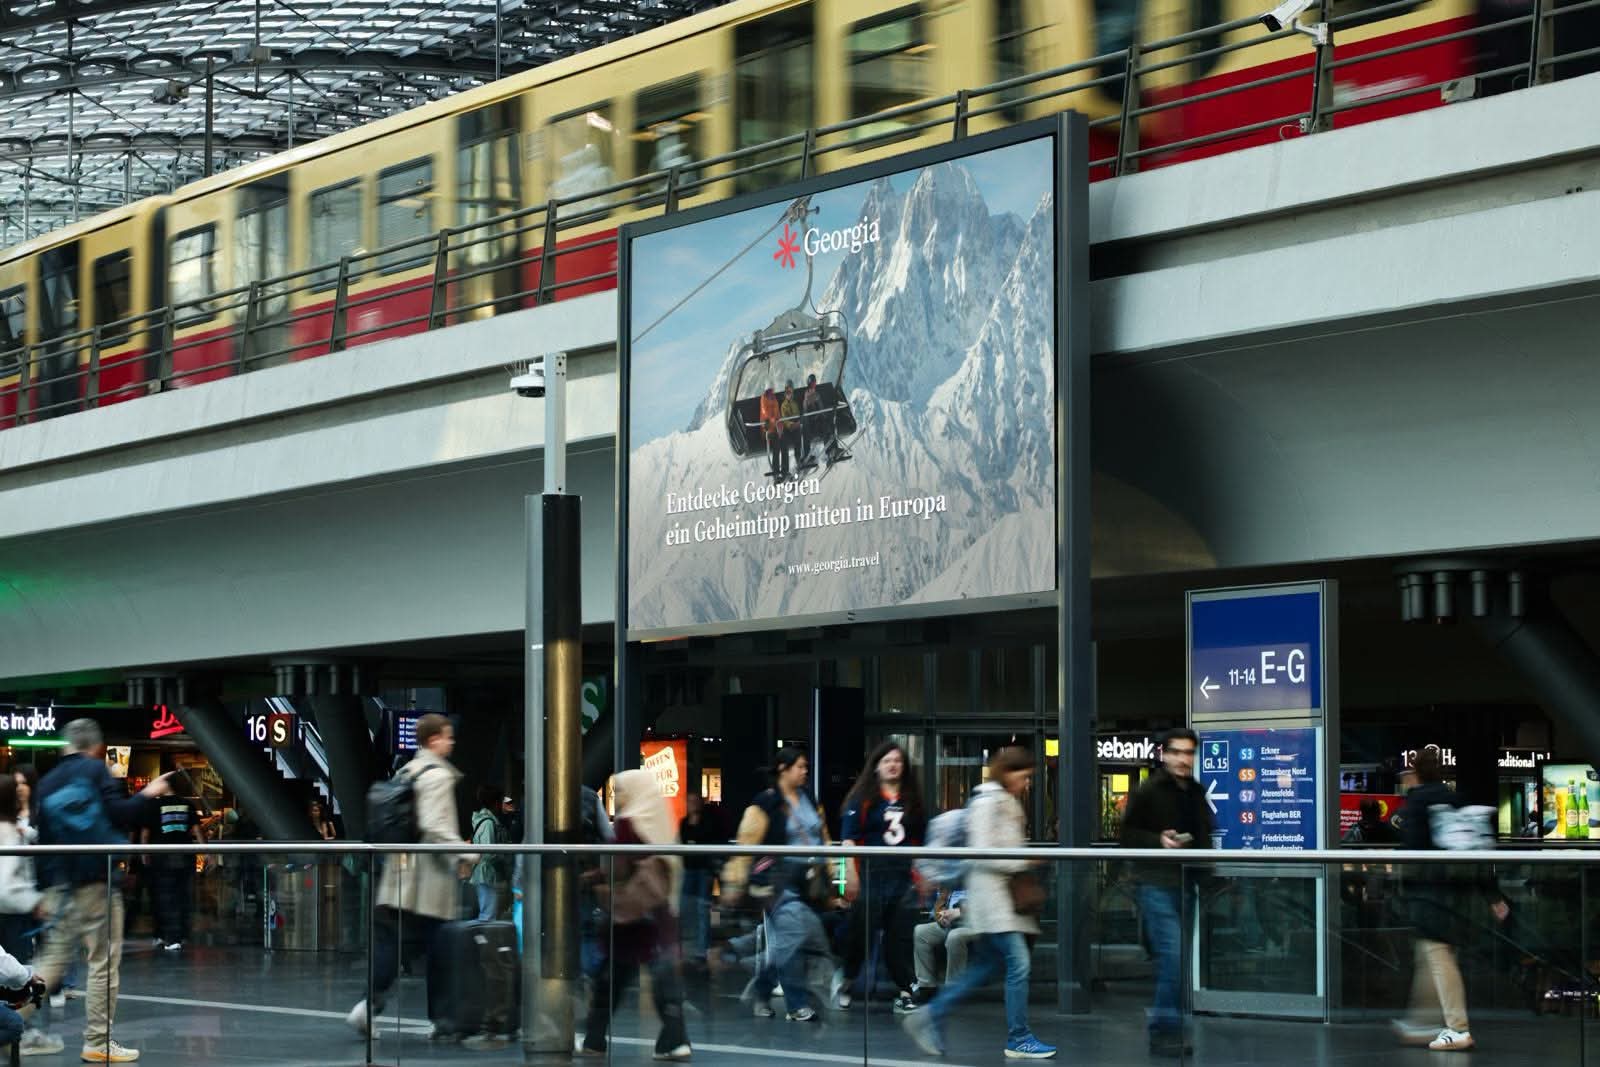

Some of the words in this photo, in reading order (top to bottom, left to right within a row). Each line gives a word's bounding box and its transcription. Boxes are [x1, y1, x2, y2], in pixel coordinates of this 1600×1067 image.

[804, 216, 880, 256] Georgia
[666, 484, 740, 514] Entdecke
[744, 473, 820, 503] Georgien
[666, 522, 690, 546] ein
[694, 511, 790, 539] Geheimtipp
[794, 504, 851, 530] mitten
[857, 497, 873, 522] in
[879, 494, 947, 520] Europa
[788, 552, 880, 575] www.georgia.travel
[1229, 667, 1256, 686] 11-14
[1261, 649, 1305, 684] E-G
[11, 712, 25, 730] im
[27, 707, 56, 737] glück
[247, 715, 266, 741] 16
[273, 719, 286, 742] S
[1211, 743, 1220, 756] S
[1241, 748, 1252, 760] S3
[1261, 747, 1280, 755] Erkner
[646, 753, 671, 769] OFFEN
[1217, 757, 1228, 769] 15
[1241, 769, 1253, 781] S5
[1261, 768, 1291, 777] Strausberg
[1291, 767, 1307, 776] Nord
[1241, 790, 1253, 802] S7
[1261, 789, 1295, 797] Ahrensfelde
[1241, 812, 1253, 823] S9
[1261, 810, 1288, 820] Flughafen
[1289, 811, 1301, 819] BER
[883, 810, 906, 845] 3
[1261, 834, 1304, 842] Friedrichstraße
